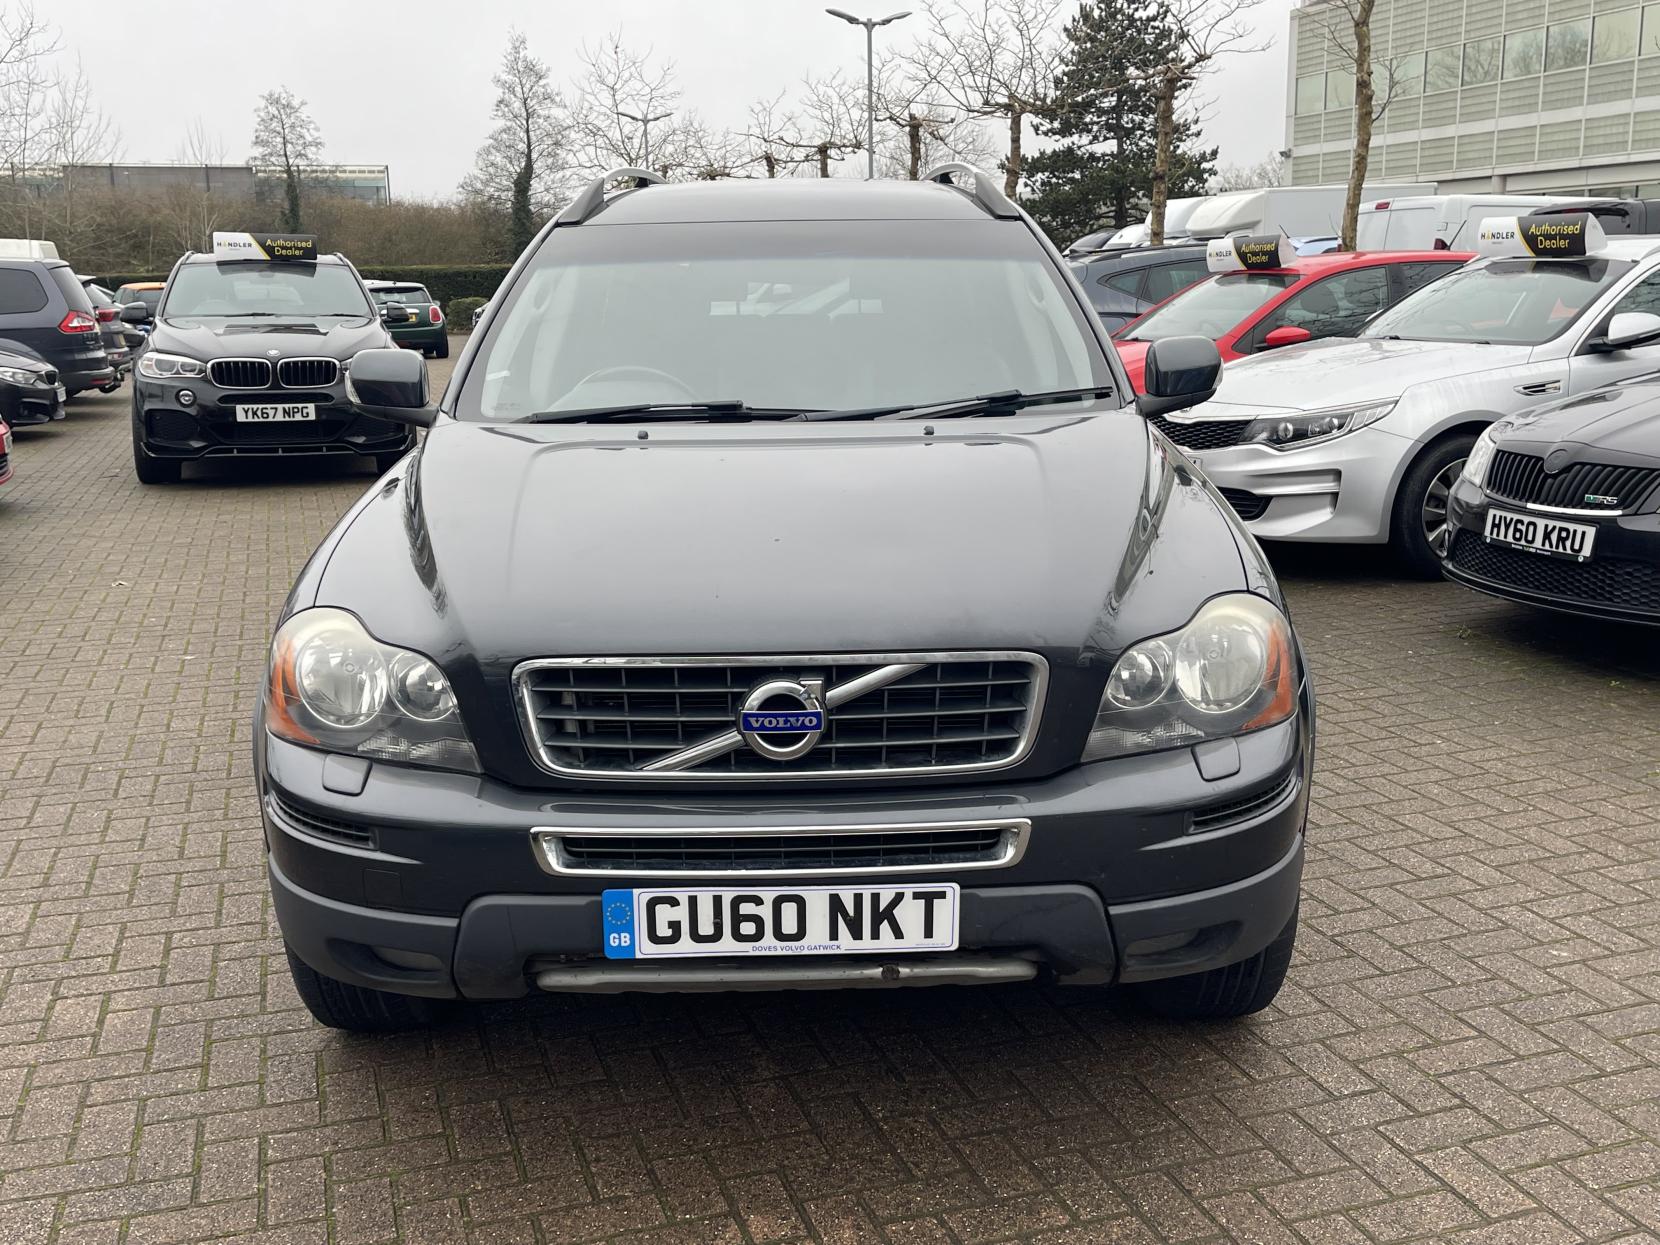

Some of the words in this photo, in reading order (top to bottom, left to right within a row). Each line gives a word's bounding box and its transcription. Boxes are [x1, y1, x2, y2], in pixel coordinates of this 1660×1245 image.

[1529, 221, 1582, 236] Authorised
[265, 239, 312, 248] Authorised
[1240, 240, 1276, 253] Authorised
[1537, 236, 1570, 249] Dealer
[274, 247, 304, 256] Dealer
[1246, 253, 1269, 263] Dealer
[242, 407, 279, 420] YK67
[282, 406, 310, 419] NPG
[1489, 513, 1538, 545] HY60
[1541, 523, 1586, 554] KRU
[747, 716, 818, 728] VOLVO
[645, 894, 807, 945] GU60
[828, 890, 947, 942] NKT
[609, 932, 631, 947] GB
[780, 944, 805, 952] VOLVO
